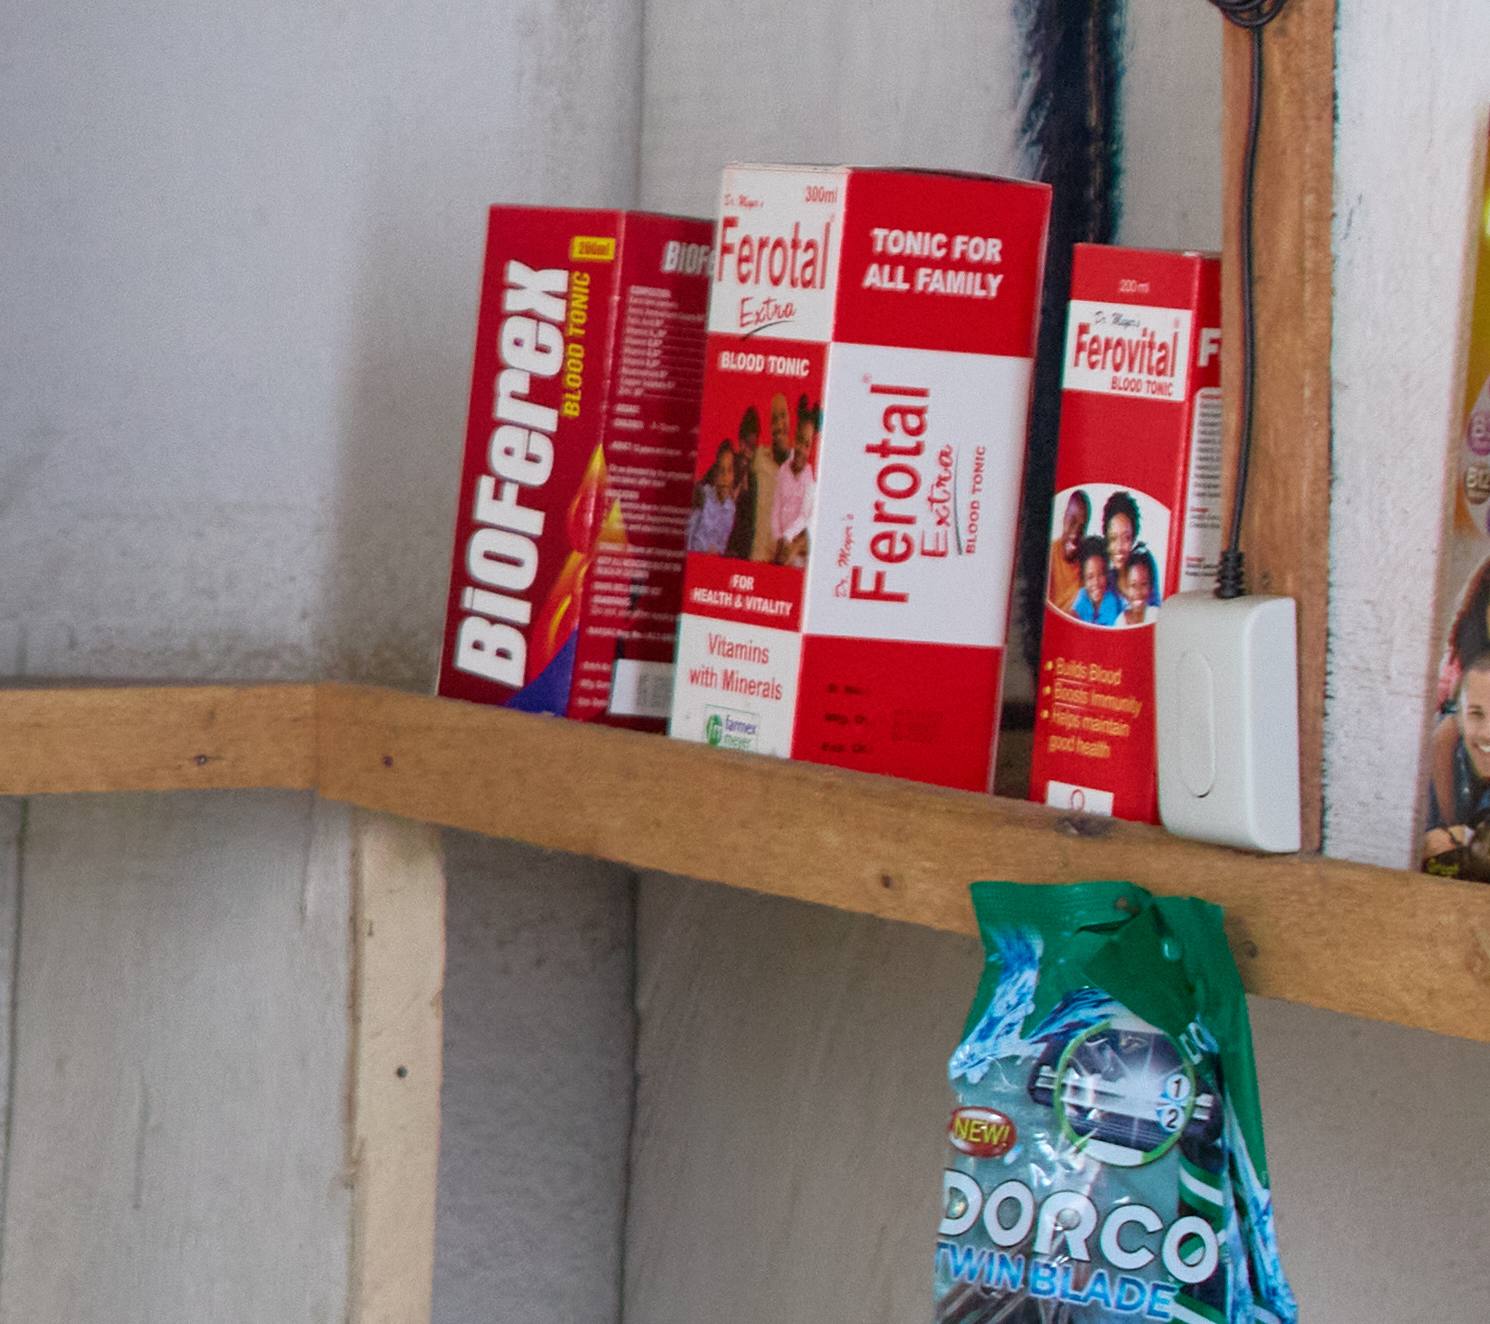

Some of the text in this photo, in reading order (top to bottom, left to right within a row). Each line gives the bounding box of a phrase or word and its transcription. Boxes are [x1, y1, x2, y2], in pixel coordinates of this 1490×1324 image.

[717, 216, 831, 290] Ferotal
[872, 228, 1002, 263] TONIC FOR
[863, 263, 1003, 299] ALL FAMILY
[562, 271, 591, 418] BLOOD TONIC
[1074, 322, 1178, 377] Ferovital
[1111, 376, 1173, 396] BLOOD TONIC
[849, 384, 930, 603] Ferotal
[730, 574, 754, 591] FOR
[708, 633, 769, 665] Vitamins
[689, 665, 782, 701] with Minerals
[1090, 663, 1122, 686] Blood
[1173, 1078, 1182, 1099] 1
[953, 1117, 1010, 1147] NEW!
[1166, 1108, 1178, 1129] 2
[938, 1169, 1219, 1284] DORCO
[934, 1241, 1179, 1321] TWIN BLADE
